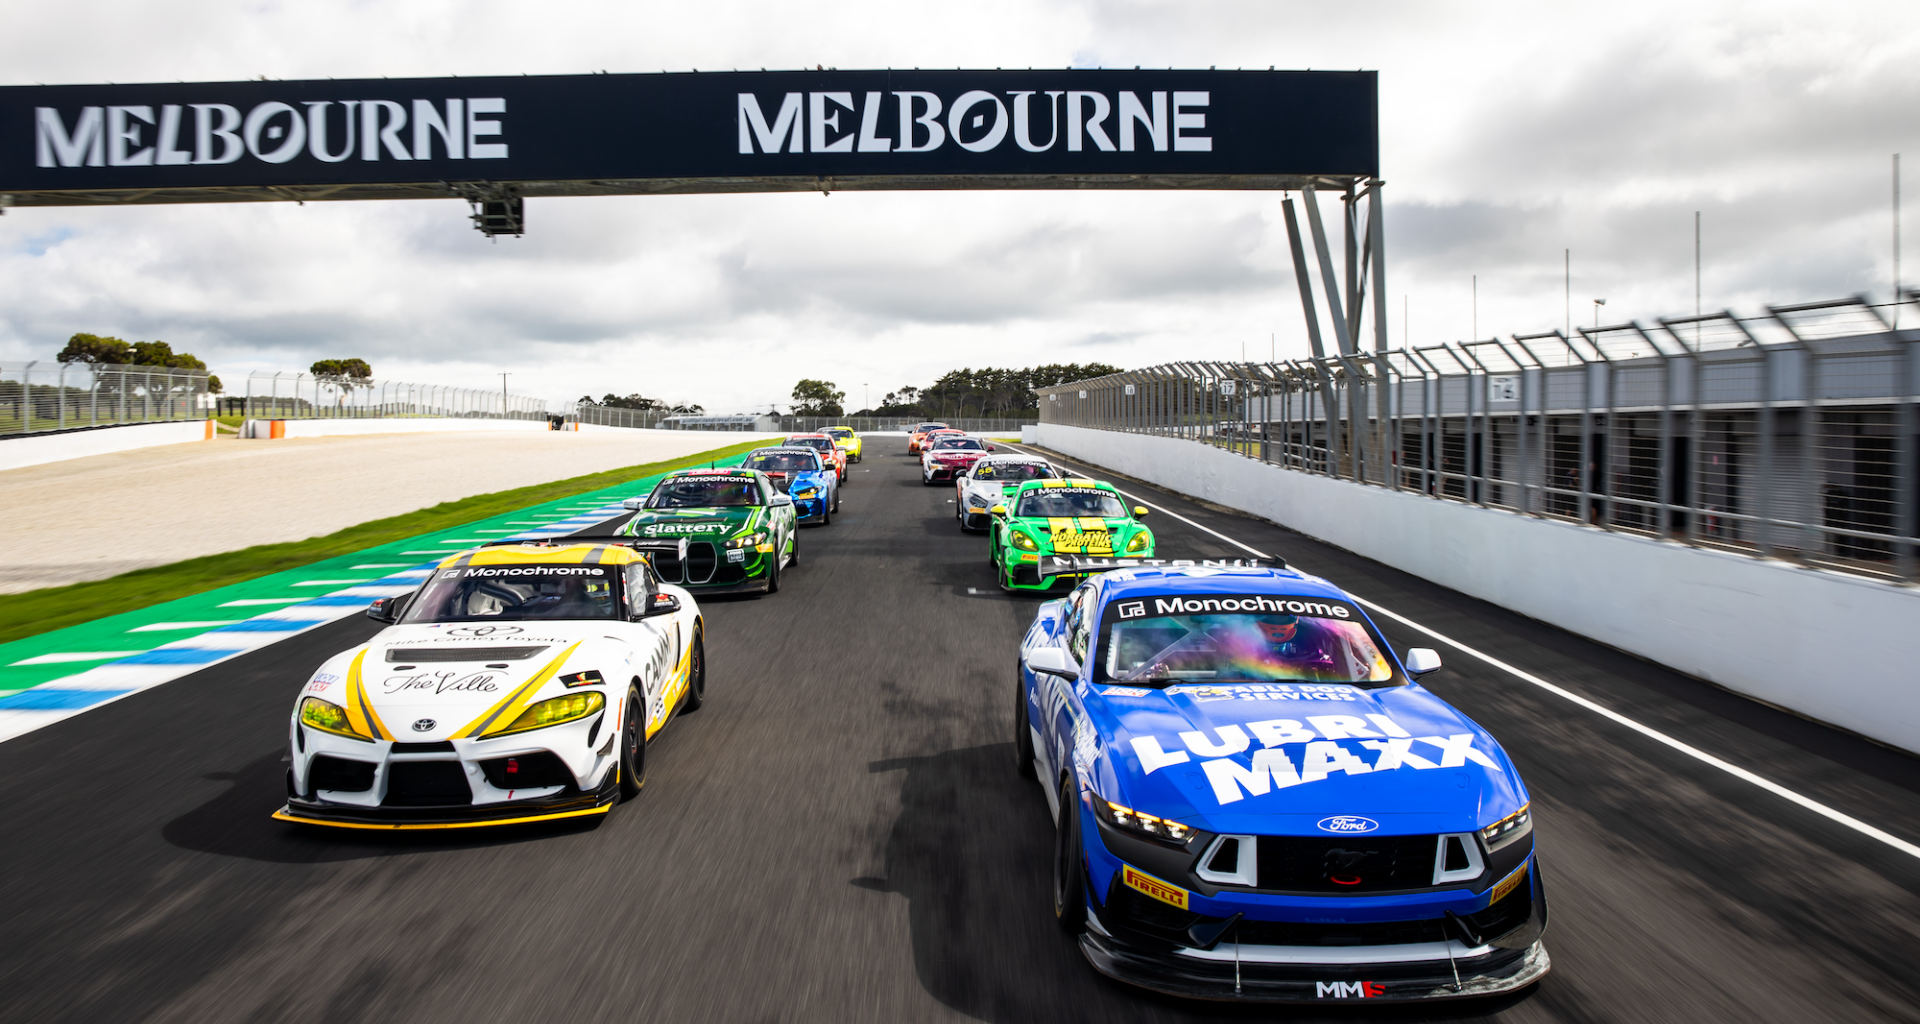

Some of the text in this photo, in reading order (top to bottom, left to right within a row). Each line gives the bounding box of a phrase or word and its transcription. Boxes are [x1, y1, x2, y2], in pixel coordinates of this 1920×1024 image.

[737, 89, 1213, 154] MELBOURNE
[35, 97, 509, 168] MELBOURNE
[1223, 384, 1234, 394] 17
[990, 460, 1047, 468] Monochrome
[977, 467, 993, 475] 58
[676, 475, 755, 484] Monochrome
[1038, 487, 1117, 498] Monochrome
[1064, 539, 1112, 548] PROTEINS
[463, 566, 605, 579] Monochrome
[1154, 595, 1350, 619] Monochrome
[384, 639, 428, 647] Mike
[505, 635, 567, 644] Toyota
[383, 670, 509, 695] The Ville
[1239, 692, 1356, 701] SERVICES
[1129, 713, 1412, 776] LUBRI
[1200, 734, 1502, 805] MAXX
[1329, 818, 1367, 830] Ford
[1126, 869, 1184, 906] PIRELLI
